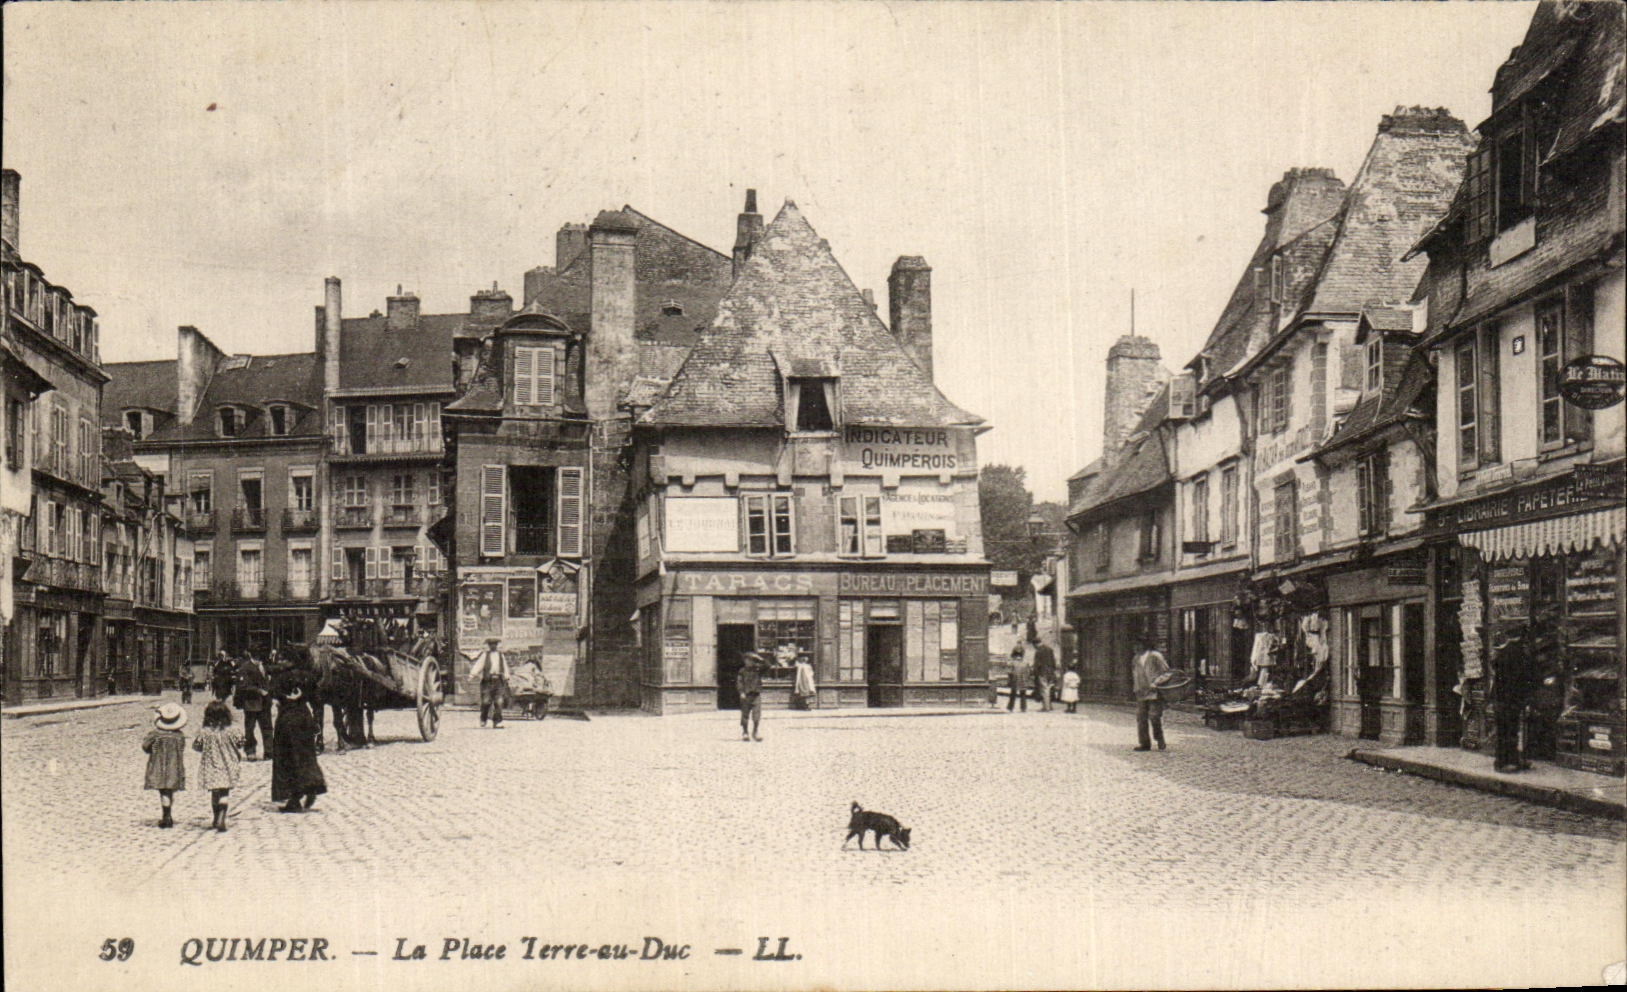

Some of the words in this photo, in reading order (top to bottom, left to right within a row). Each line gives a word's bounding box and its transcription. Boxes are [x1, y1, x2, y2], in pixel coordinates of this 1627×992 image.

[1566, 365, 1583, 382] Le
[844, 428, 949, 448] INDICATEUR
[1457, 498, 1509, 524] LIBRAIRIE
[840, 572, 896, 591] BUREAU
[906, 574, 987, 592] PLACEMENT
